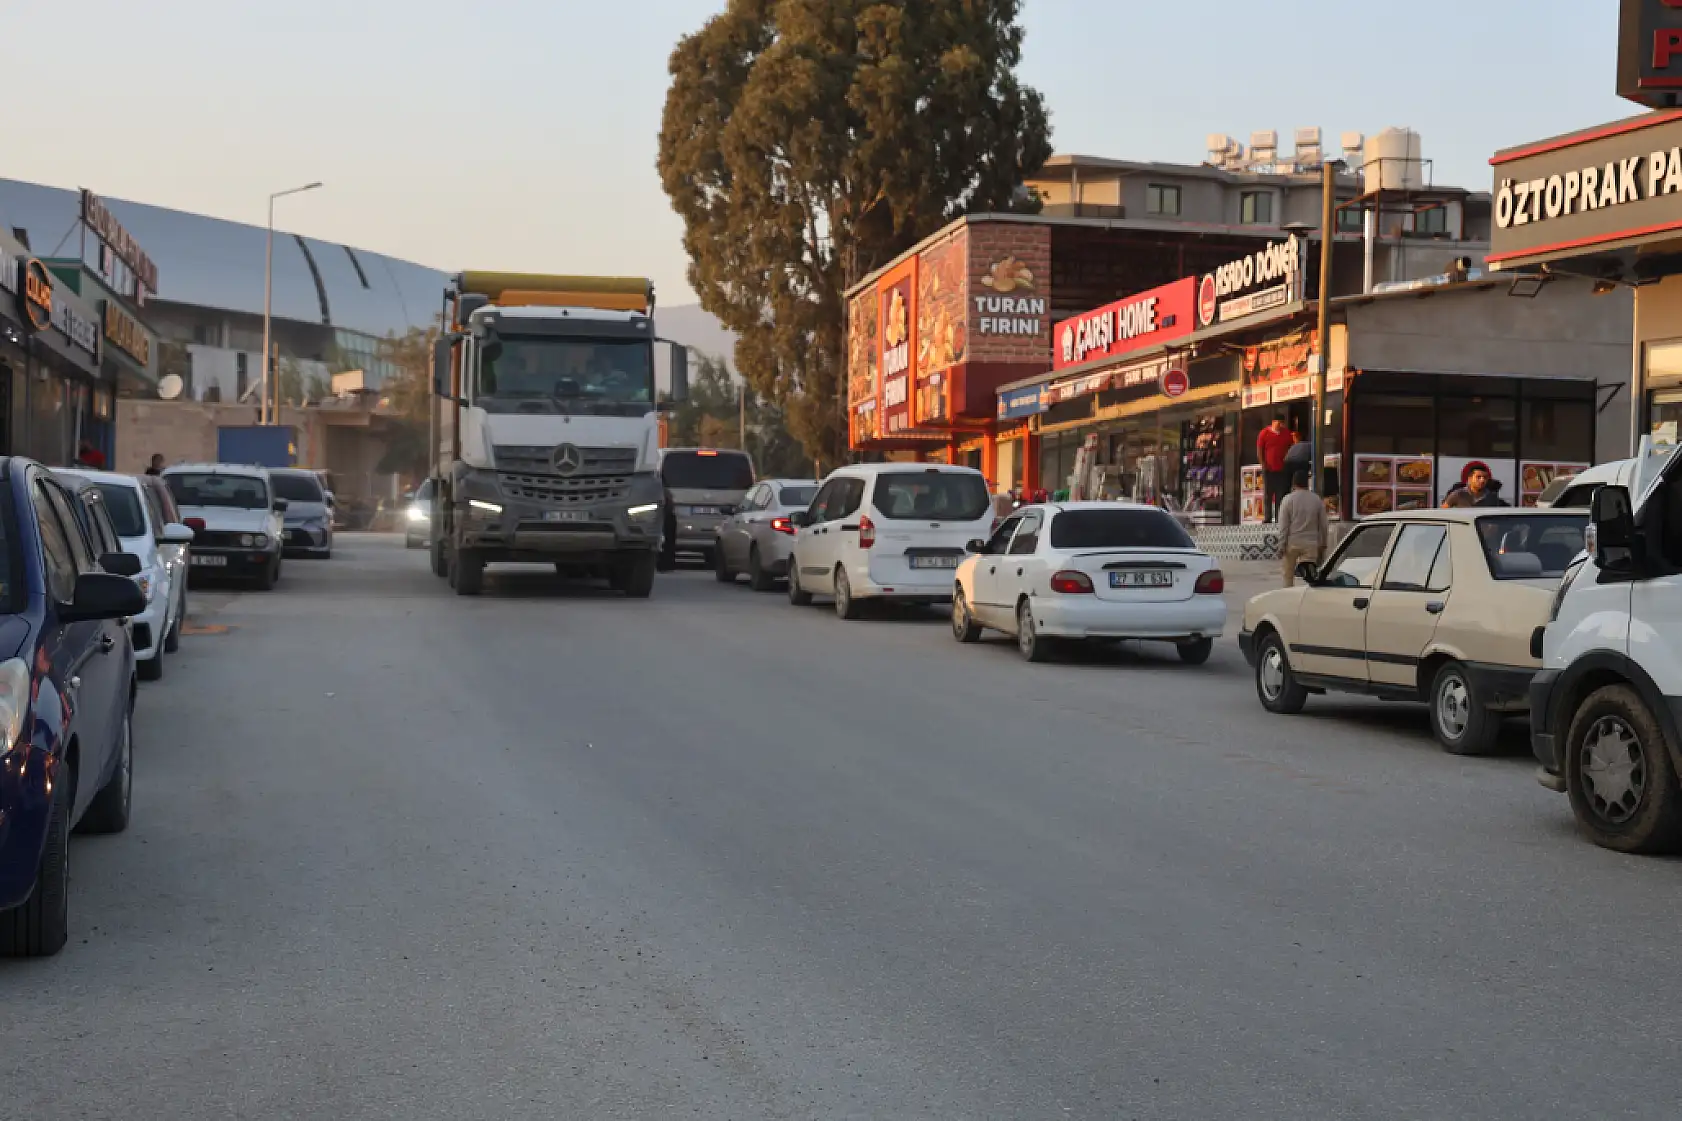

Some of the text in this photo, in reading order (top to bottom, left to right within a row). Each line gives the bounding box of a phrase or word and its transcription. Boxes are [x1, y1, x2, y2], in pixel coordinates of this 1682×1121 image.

[1496, 156, 1639, 228] ÖZTOPRAK
[976, 295, 1045, 315] TURAN
[980, 316, 1039, 334] FIRINI
[1075, 297, 1158, 360] ÇARŞI HOME
